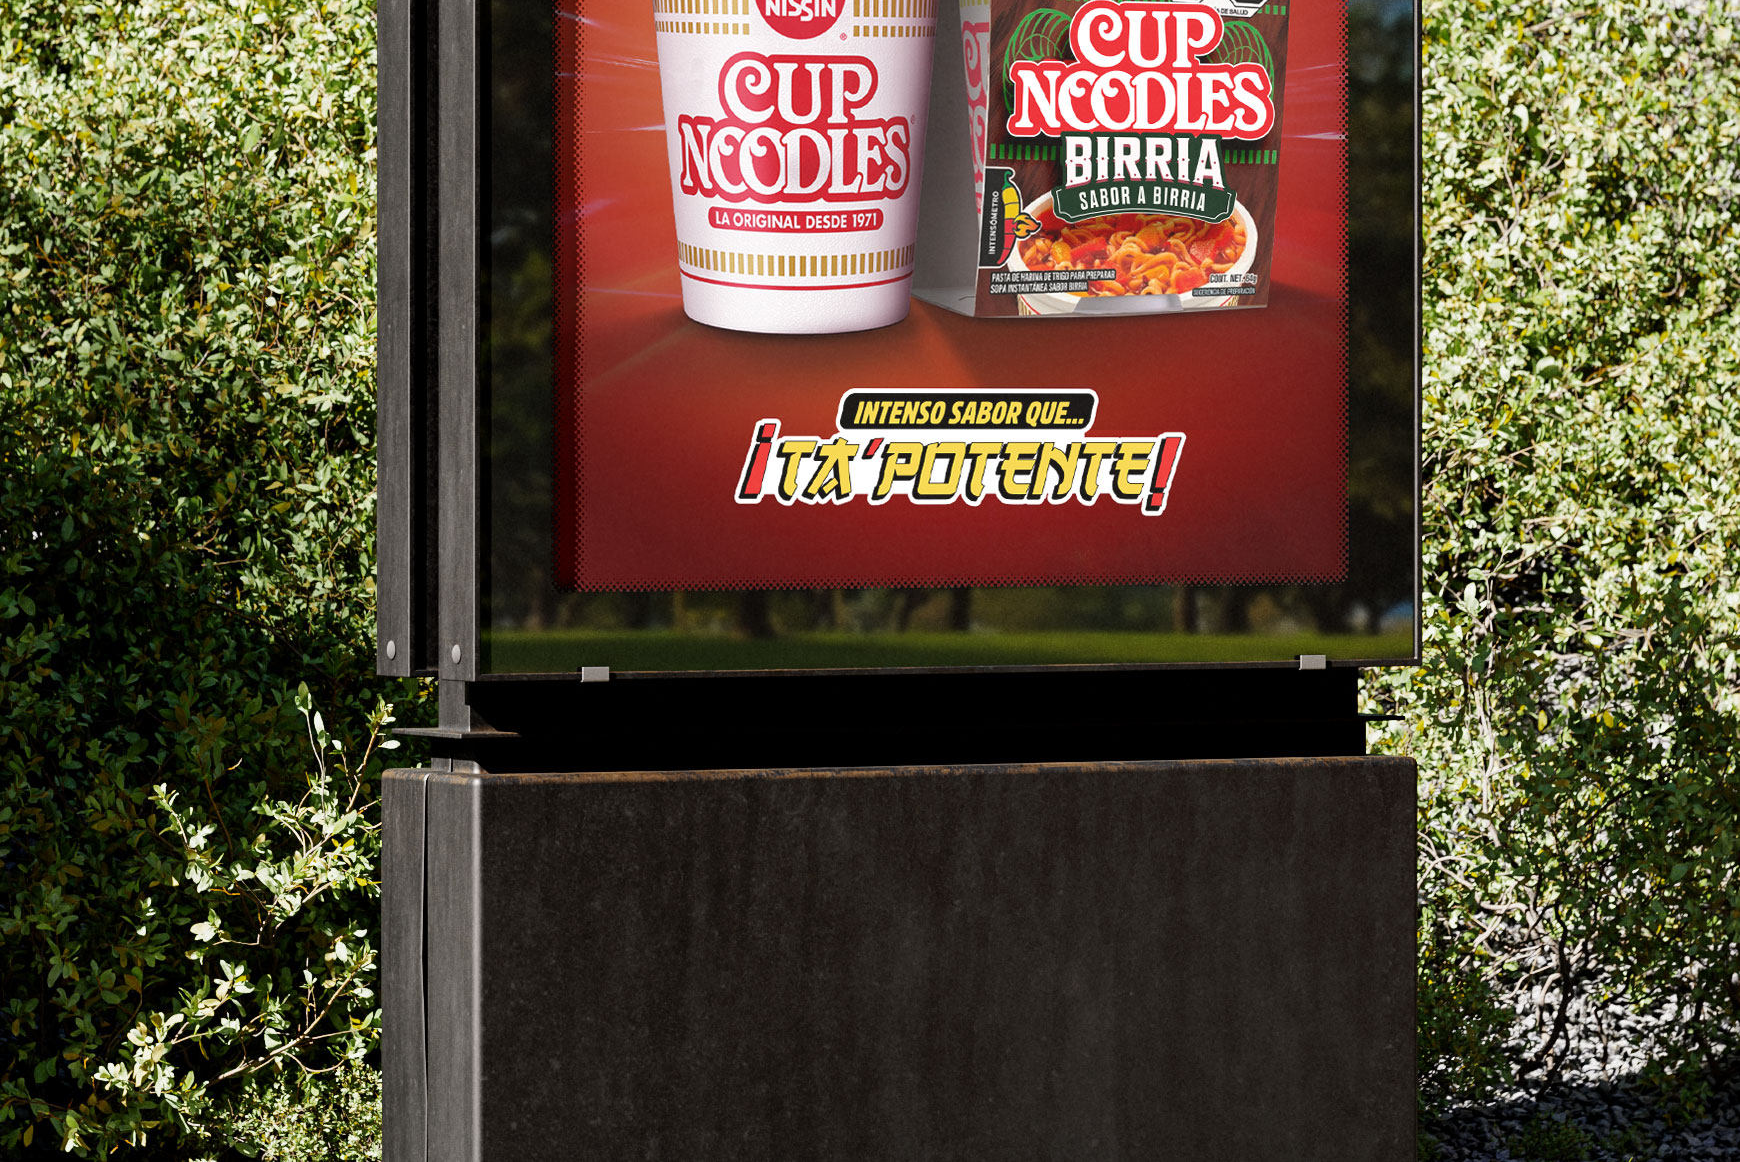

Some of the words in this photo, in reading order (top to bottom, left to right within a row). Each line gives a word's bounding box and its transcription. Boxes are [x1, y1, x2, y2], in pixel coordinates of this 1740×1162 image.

[1077, 7, 1216, 68] CUP
[724, 59, 873, 124] CUP
[1016, 69, 1268, 132] NOODLES
[683, 122, 906, 195] NOODLES
[1065, 135, 1224, 191] BIRRIA
[715, 211, 730, 226] LA
[733, 212, 801, 229] ORIGINAL
[805, 214, 847, 229] DESDE
[852, 212, 877, 227] 1971
[988, 190, 1000, 255] INTENSÓMETRO
[1079, 187, 1131, 211] SABOR
[1137, 185, 1146, 205] A
[1153, 186, 1206, 212] BIRRIA
[853, 401, 946, 426] INTENSO
[948, 401, 1022, 426] SABOR
[1025, 401, 1085, 427] QUE...
